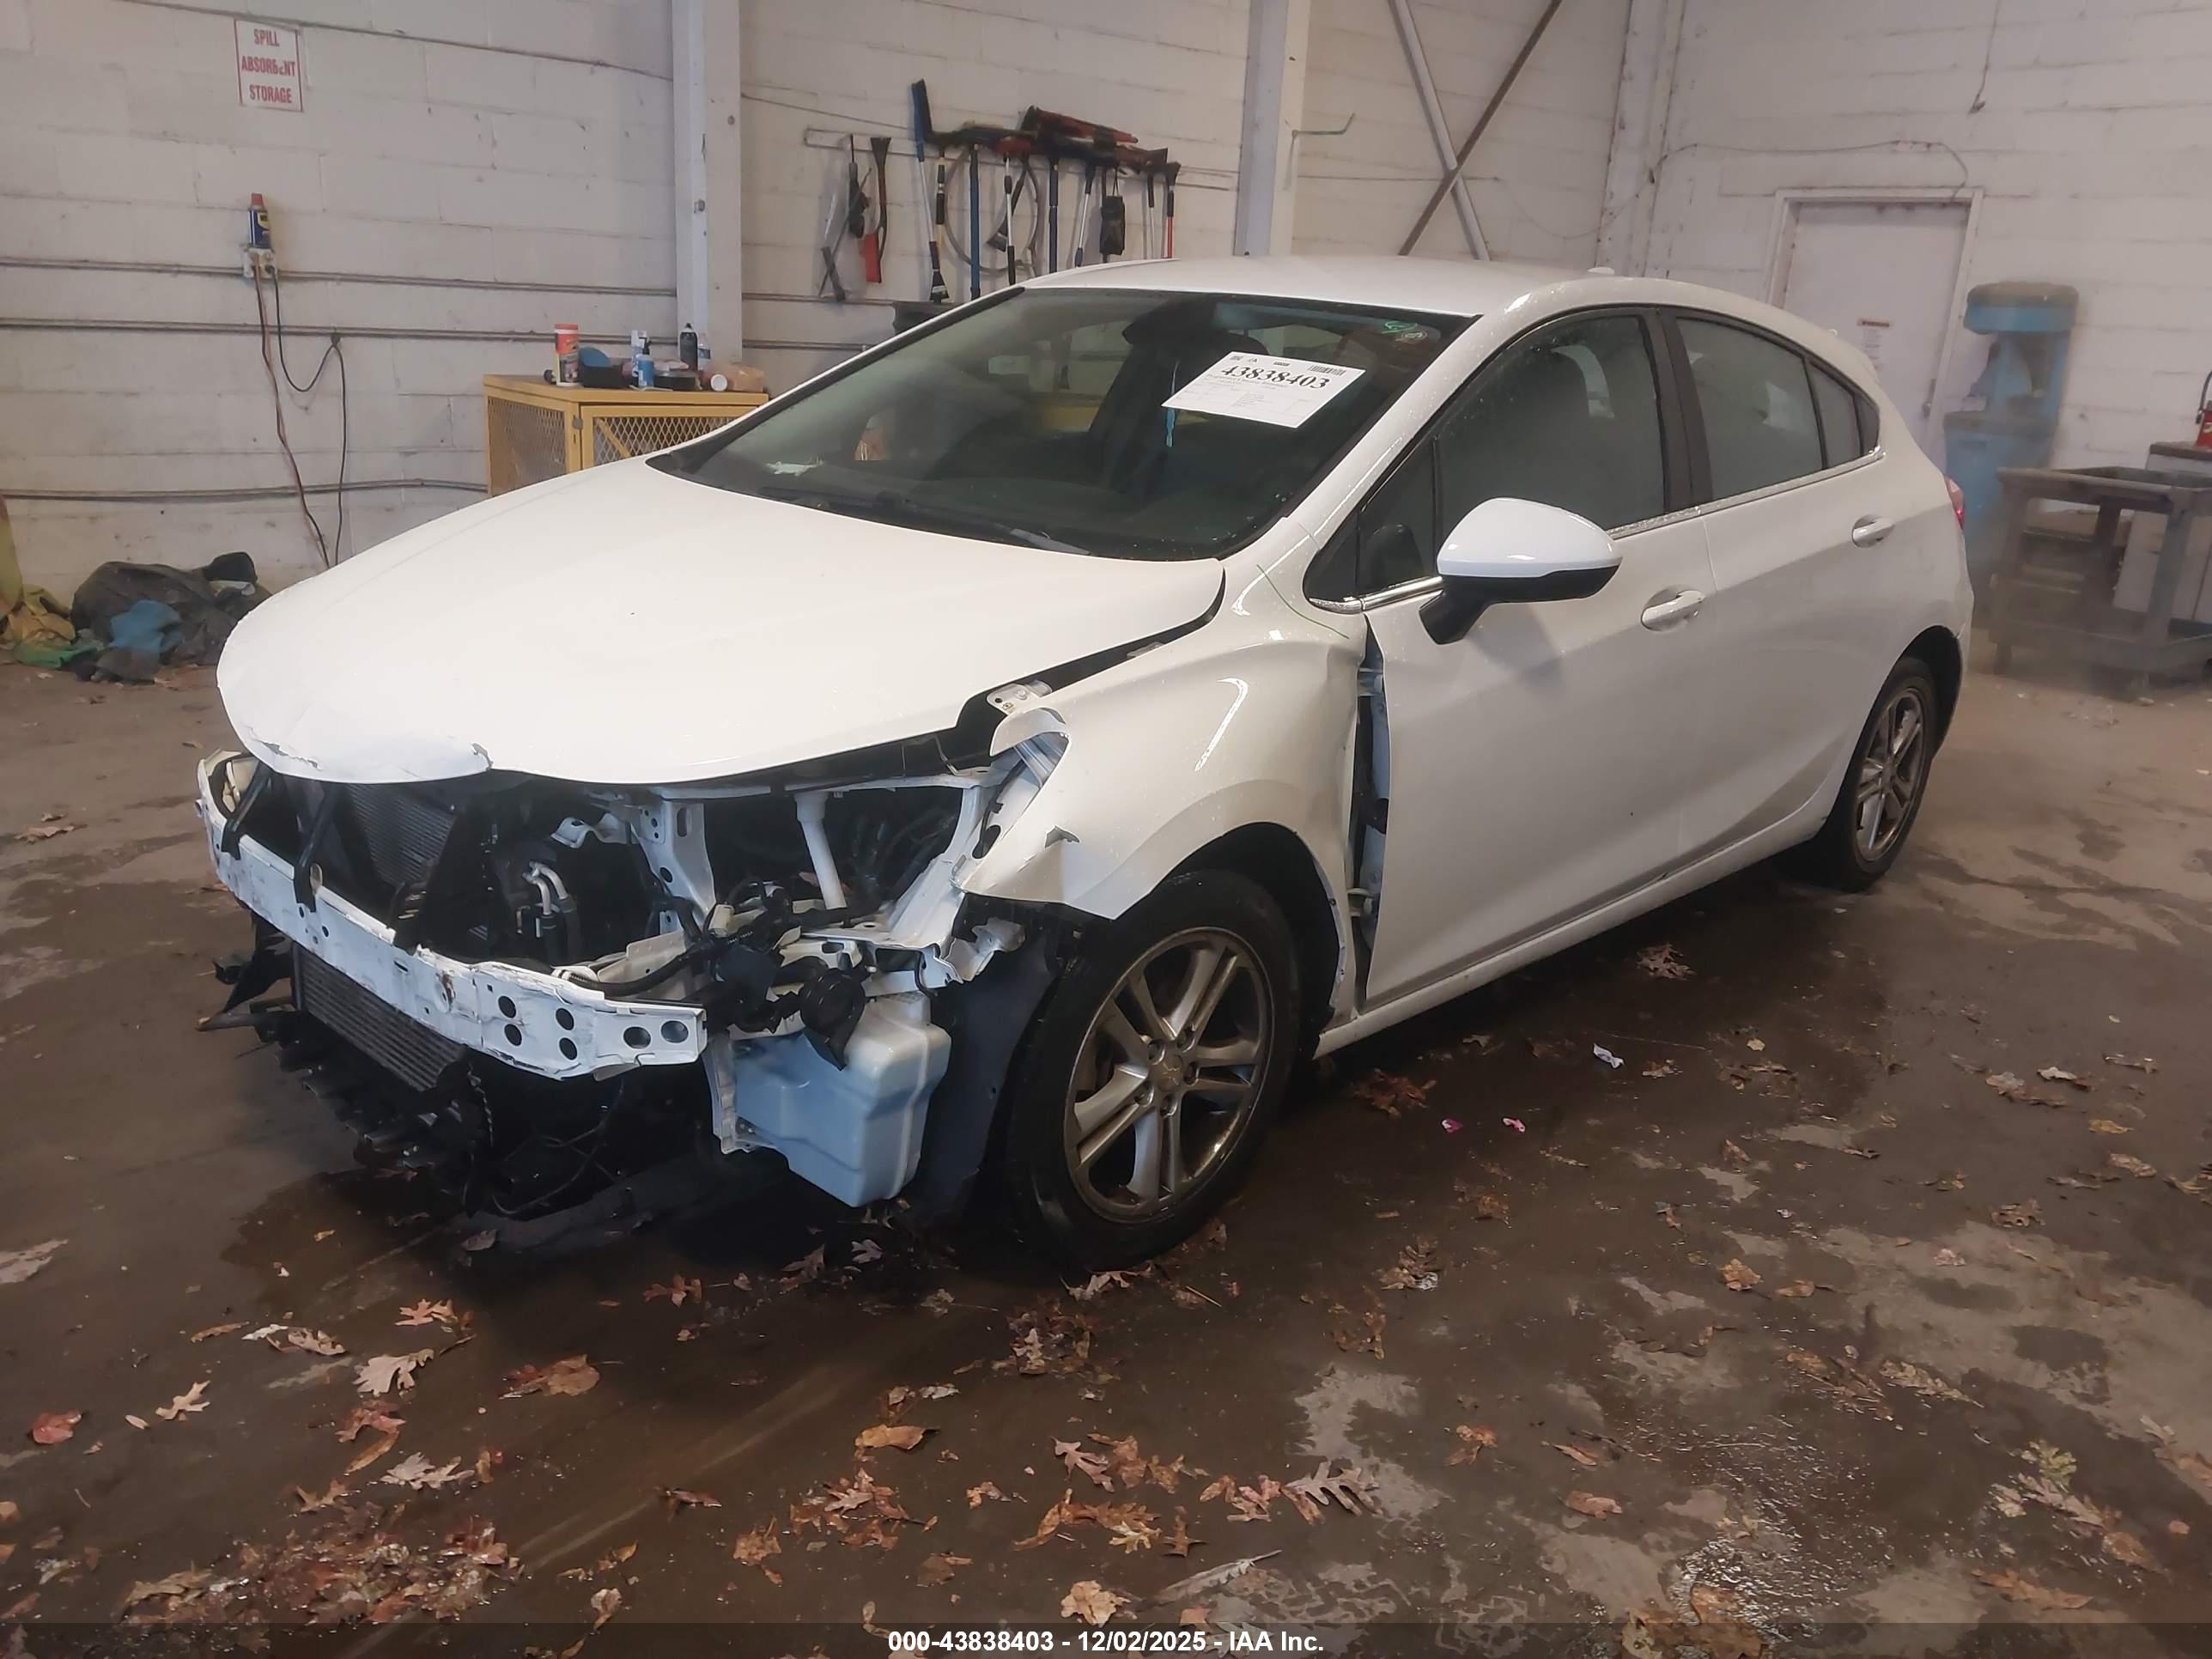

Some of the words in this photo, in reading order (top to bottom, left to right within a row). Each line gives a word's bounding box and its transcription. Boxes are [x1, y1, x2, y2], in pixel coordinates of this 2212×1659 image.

[253, 28, 280, 47] SPILL
[249, 84, 292, 104] STORAGE
[1221, 365, 1330, 389] 43838403
